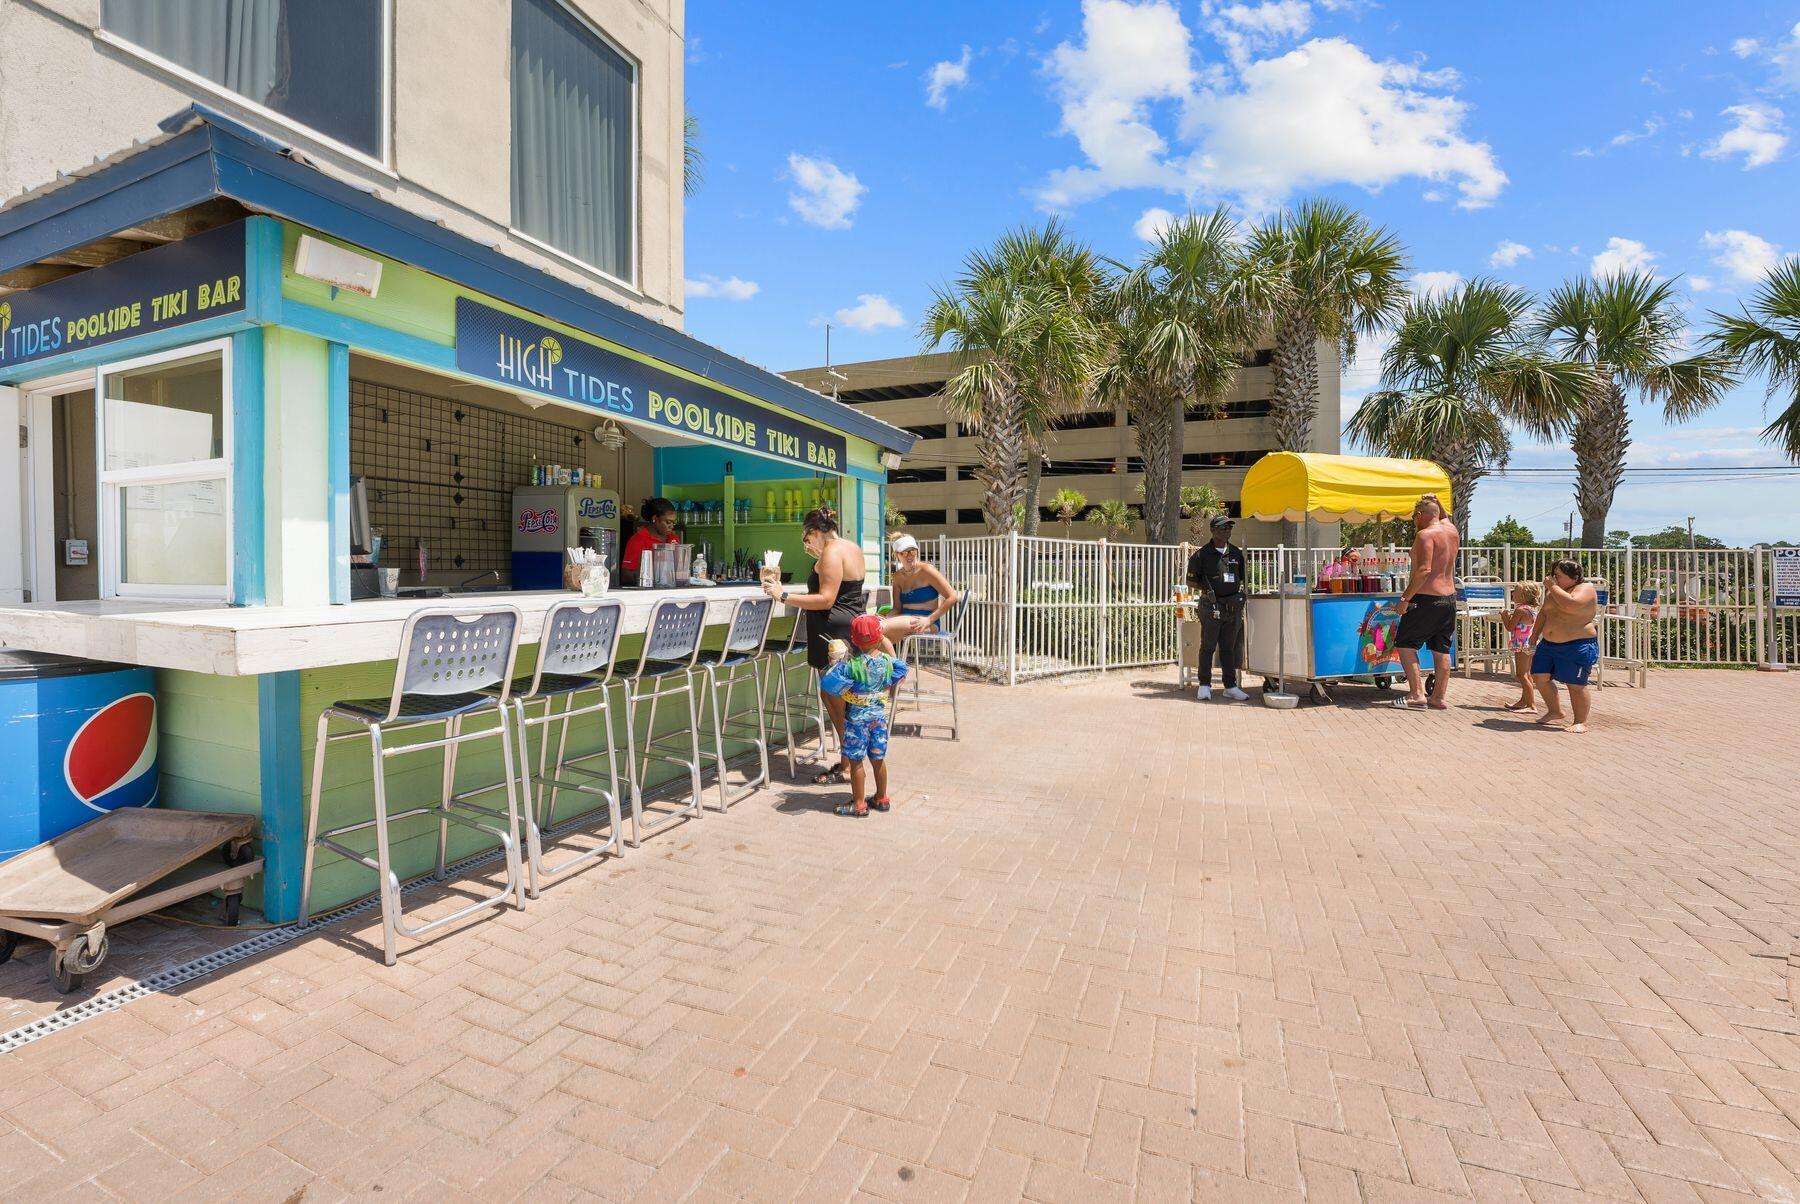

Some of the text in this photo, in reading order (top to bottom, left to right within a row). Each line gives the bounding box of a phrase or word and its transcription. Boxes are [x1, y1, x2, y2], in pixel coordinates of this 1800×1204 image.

[11, 317, 62, 358] TIDES
[67, 302, 141, 343] POOLSIDE
[152, 289, 188, 322] TIKI
[198, 276, 241, 310] BAR
[496, 334, 837, 469] HIGH TIDES POOLSIDE TIKI BAR
[1776, 549, 1800, 557] PO
